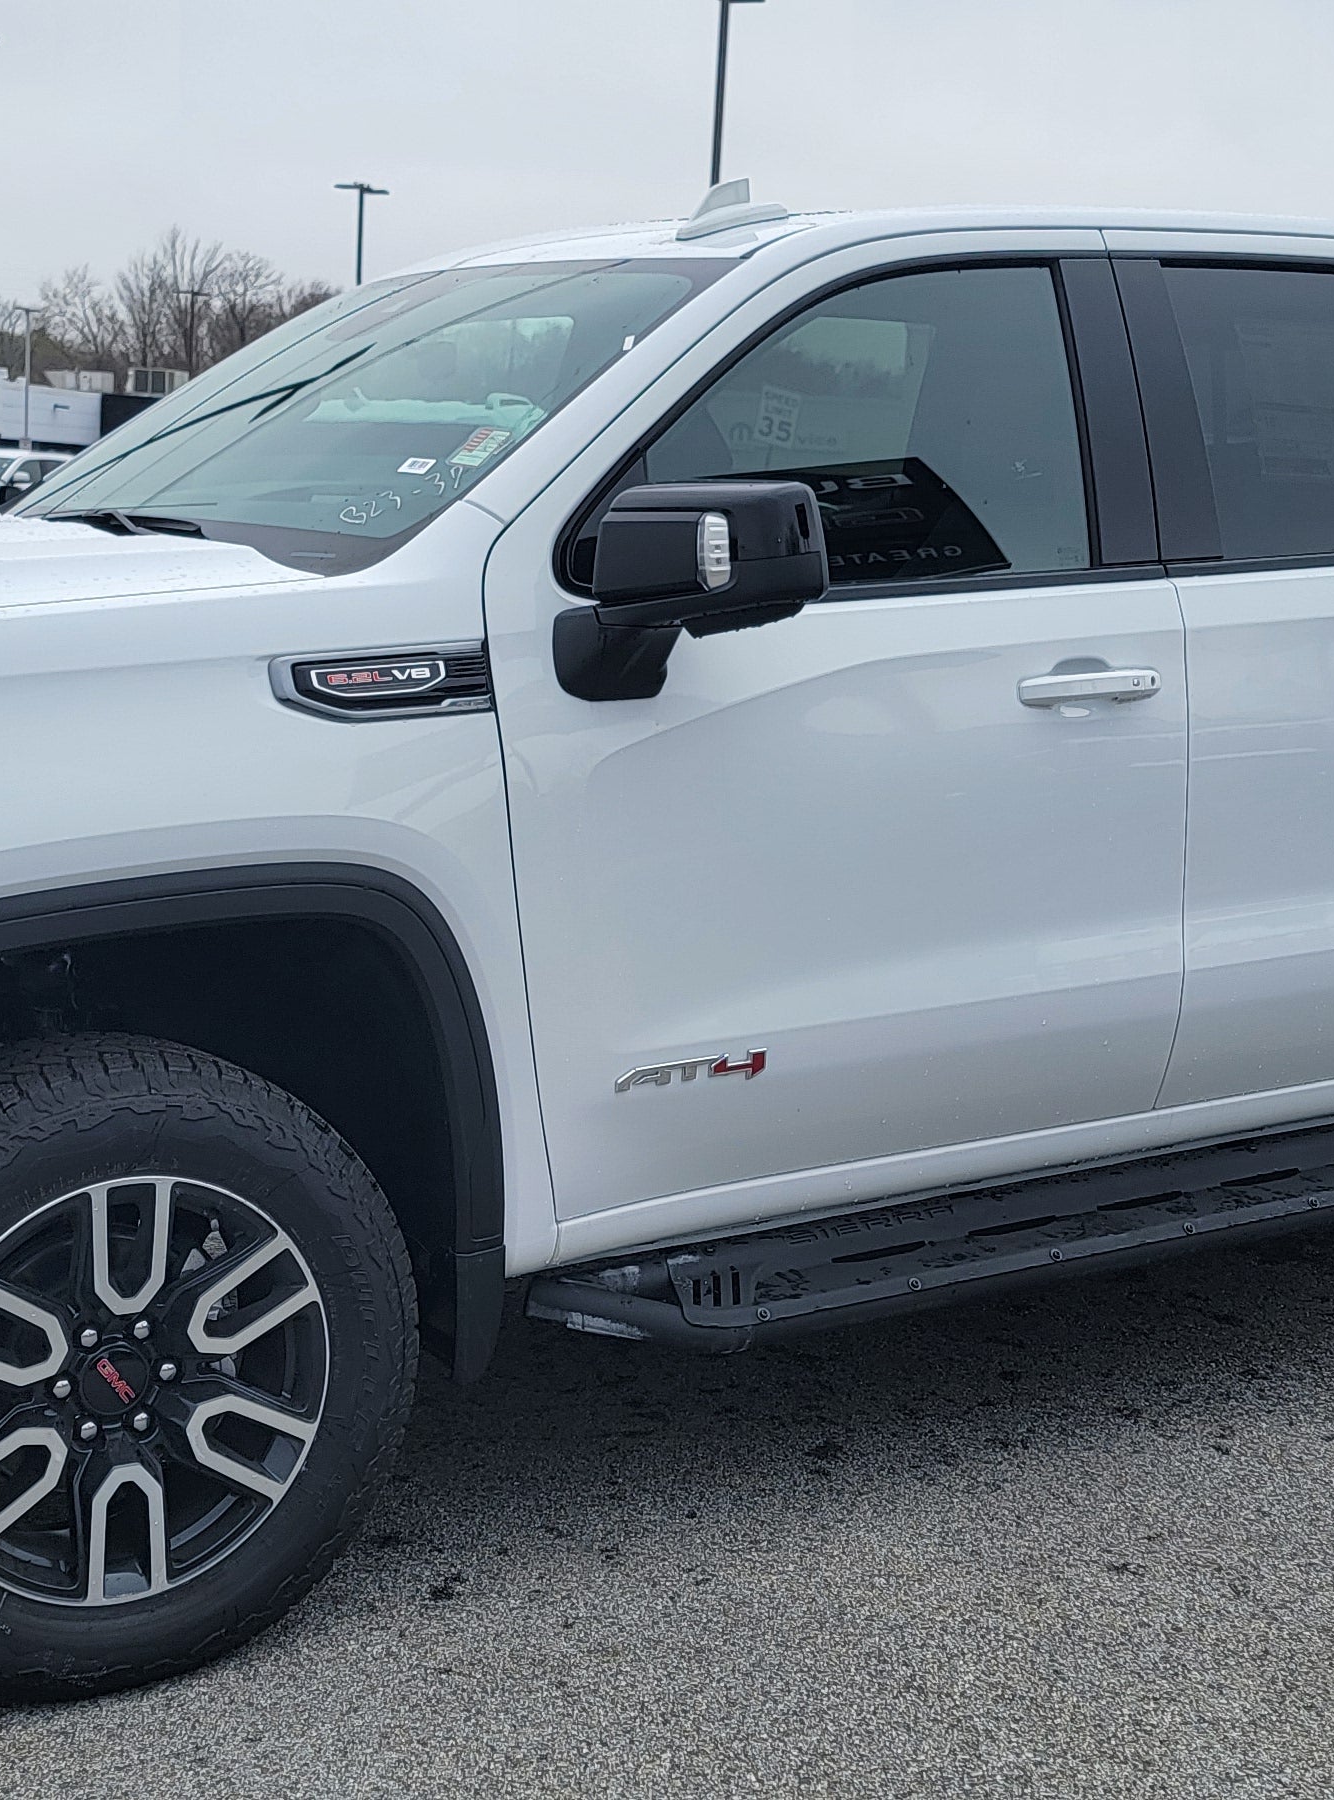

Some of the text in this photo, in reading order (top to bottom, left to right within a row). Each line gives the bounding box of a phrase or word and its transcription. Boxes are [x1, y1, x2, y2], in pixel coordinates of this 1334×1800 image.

[758, 415, 793, 442] 35
[614, 1047, 768, 1093] AT4
[786, 1204, 955, 1246] SIERRA
[96, 1358, 136, 1404] GMC
